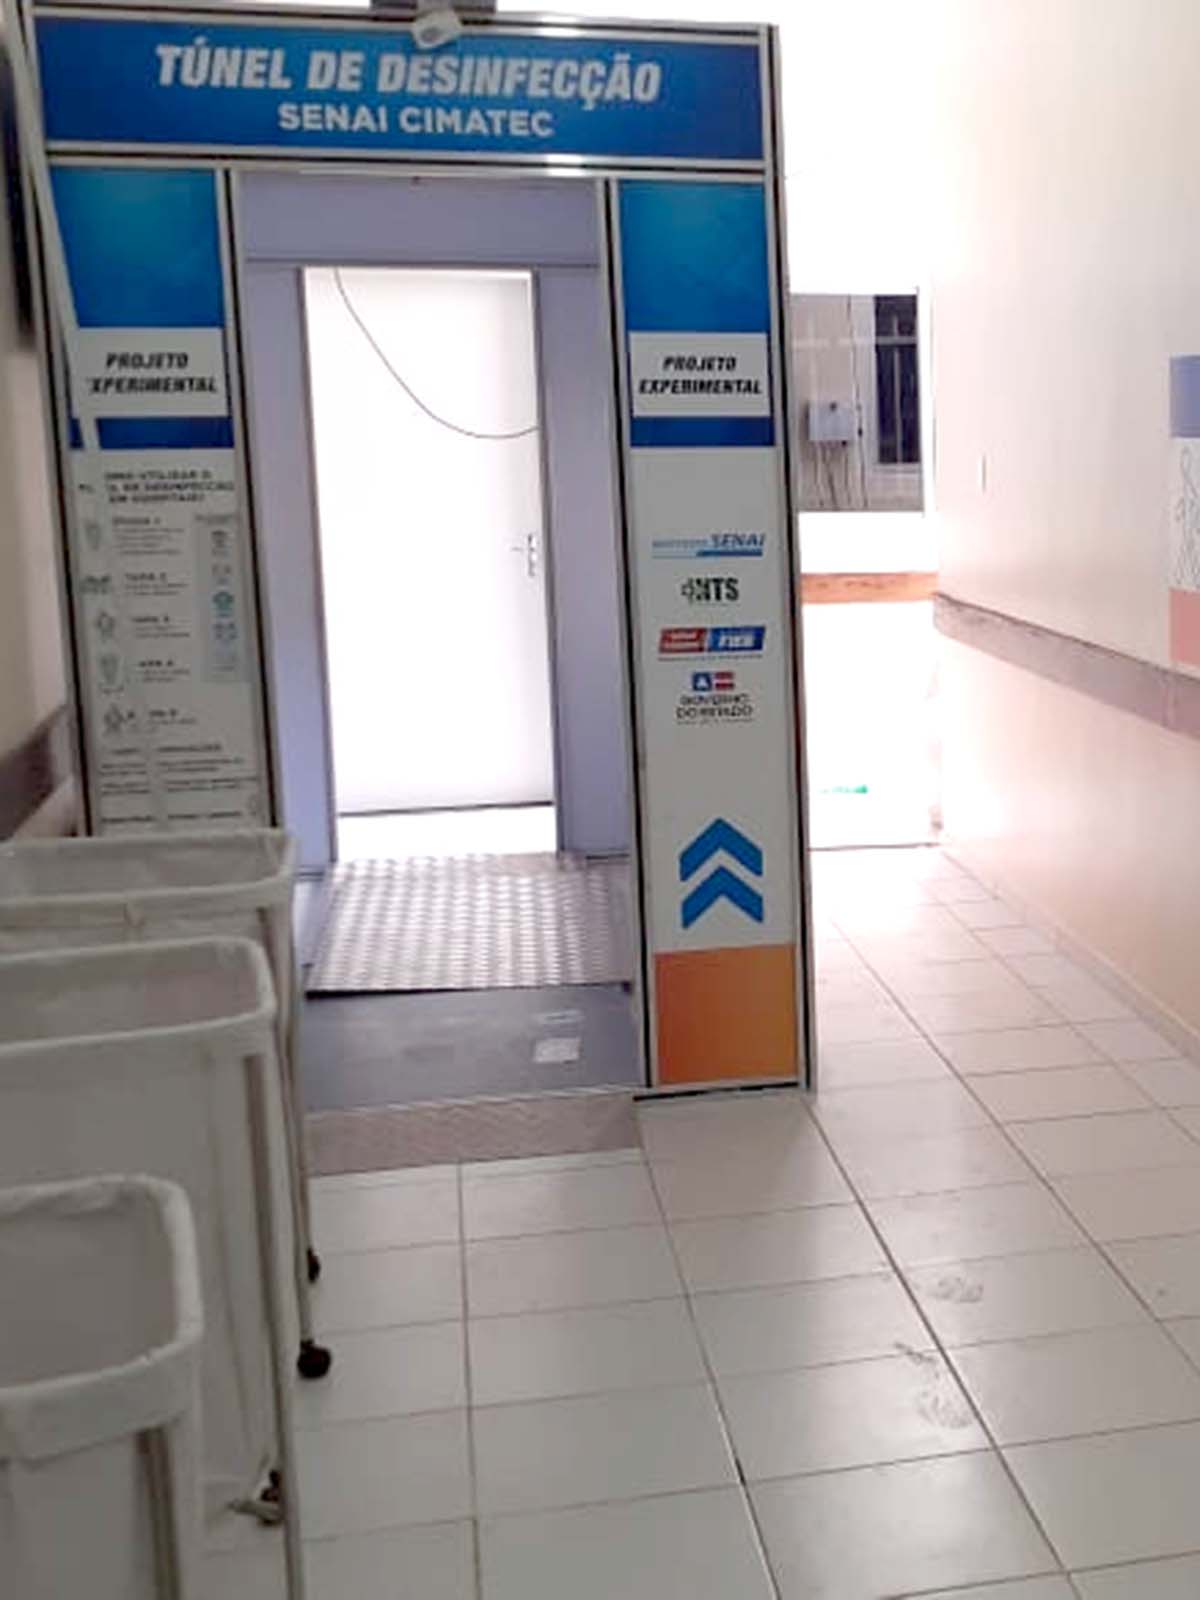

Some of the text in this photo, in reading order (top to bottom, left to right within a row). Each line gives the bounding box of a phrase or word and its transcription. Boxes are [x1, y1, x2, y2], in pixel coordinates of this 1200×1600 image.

[156, 36, 662, 110] TÚNEL DE DESINFECÇÃO
[278, 103, 556, 137] SENAI CIMATEC
[106, 352, 189, 370] PROJETO
[662, 356, 737, 371] PROJETO
[86, 376, 217, 394] XPERIMENTAL
[639, 379, 763, 395] EXPERIMENTAL
[710, 533, 766, 548] SENAI
